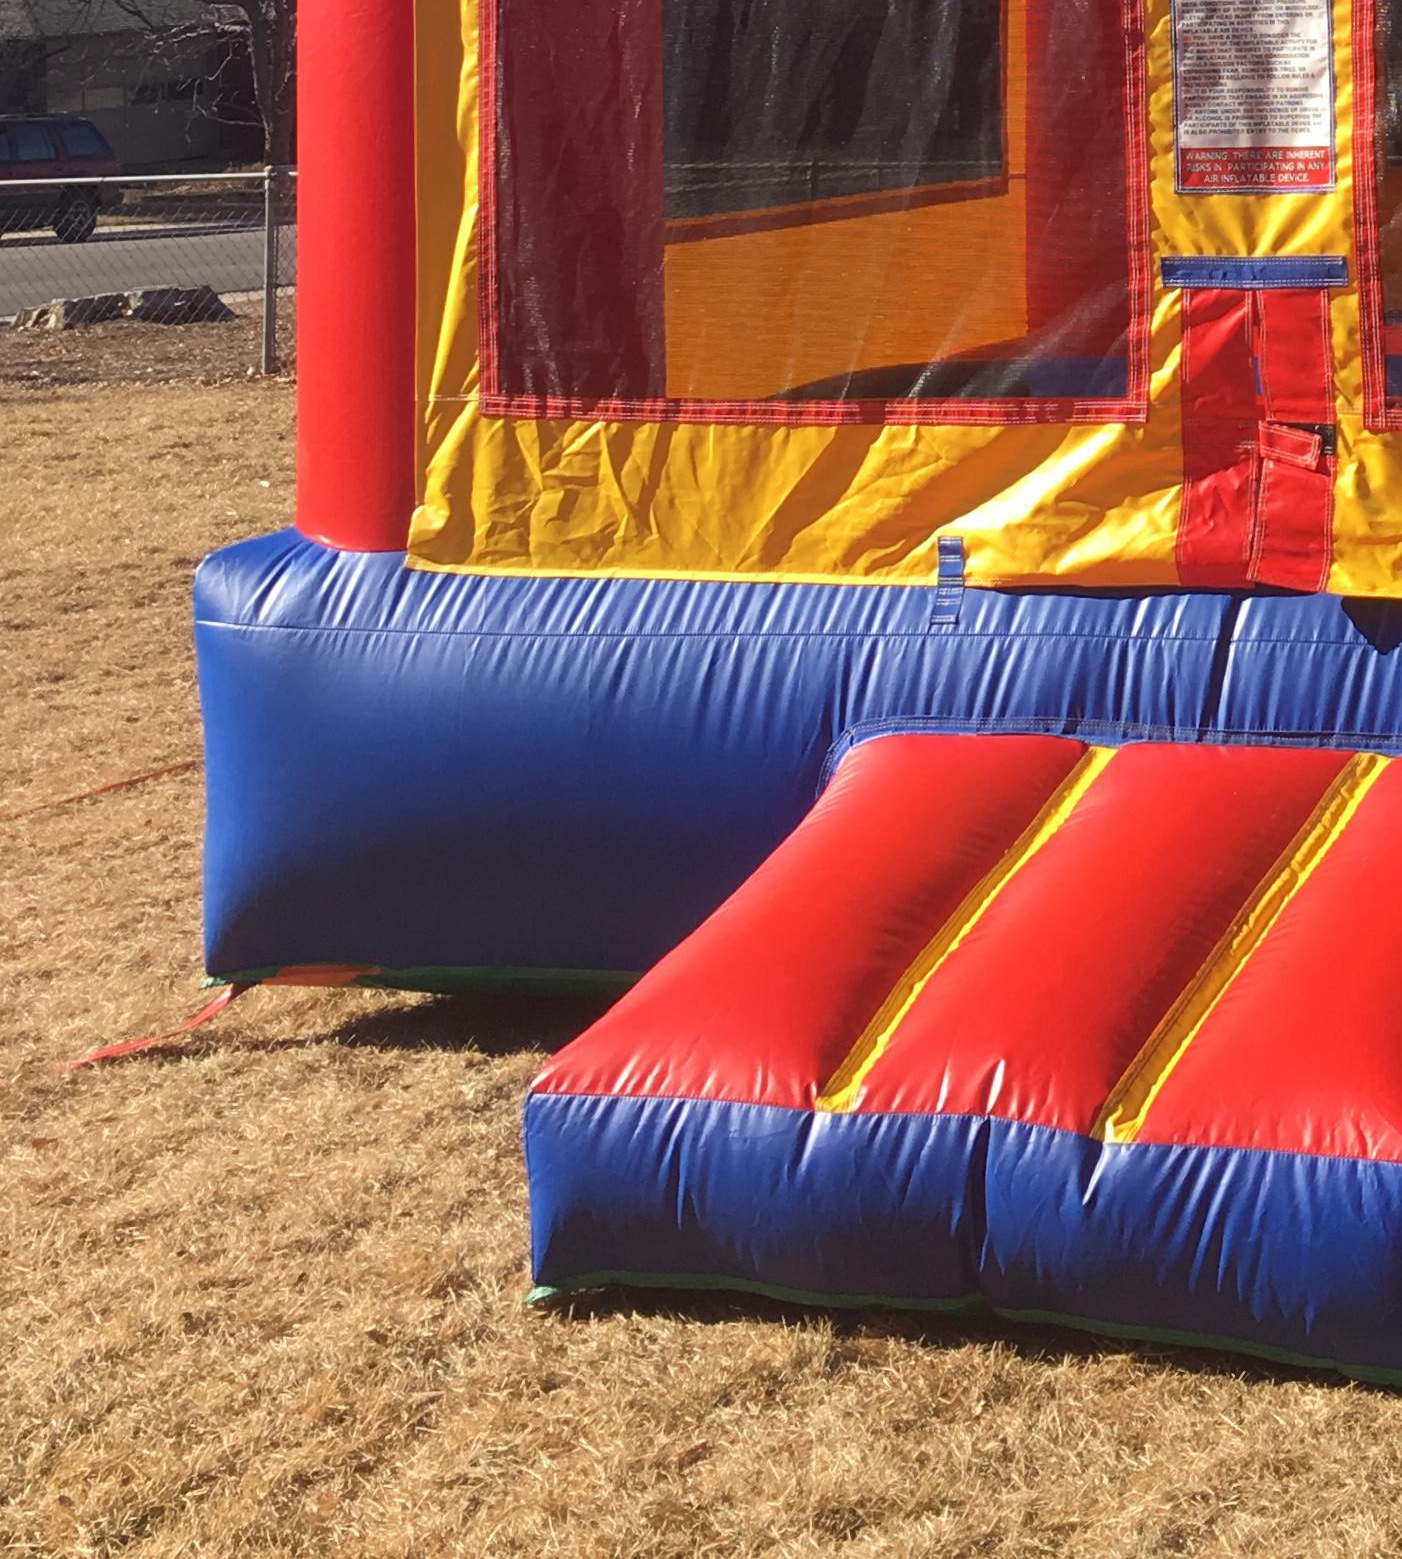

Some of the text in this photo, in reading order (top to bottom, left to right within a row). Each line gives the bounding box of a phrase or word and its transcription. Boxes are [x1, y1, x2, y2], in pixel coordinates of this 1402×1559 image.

[1265, 150, 1283, 160] ARE
[1228, 162, 1294, 171] PARTICIPATING
[1296, 161, 1305, 170] IN
[1308, 161, 1325, 170] ANY
[1203, 174, 1218, 183] AIR
